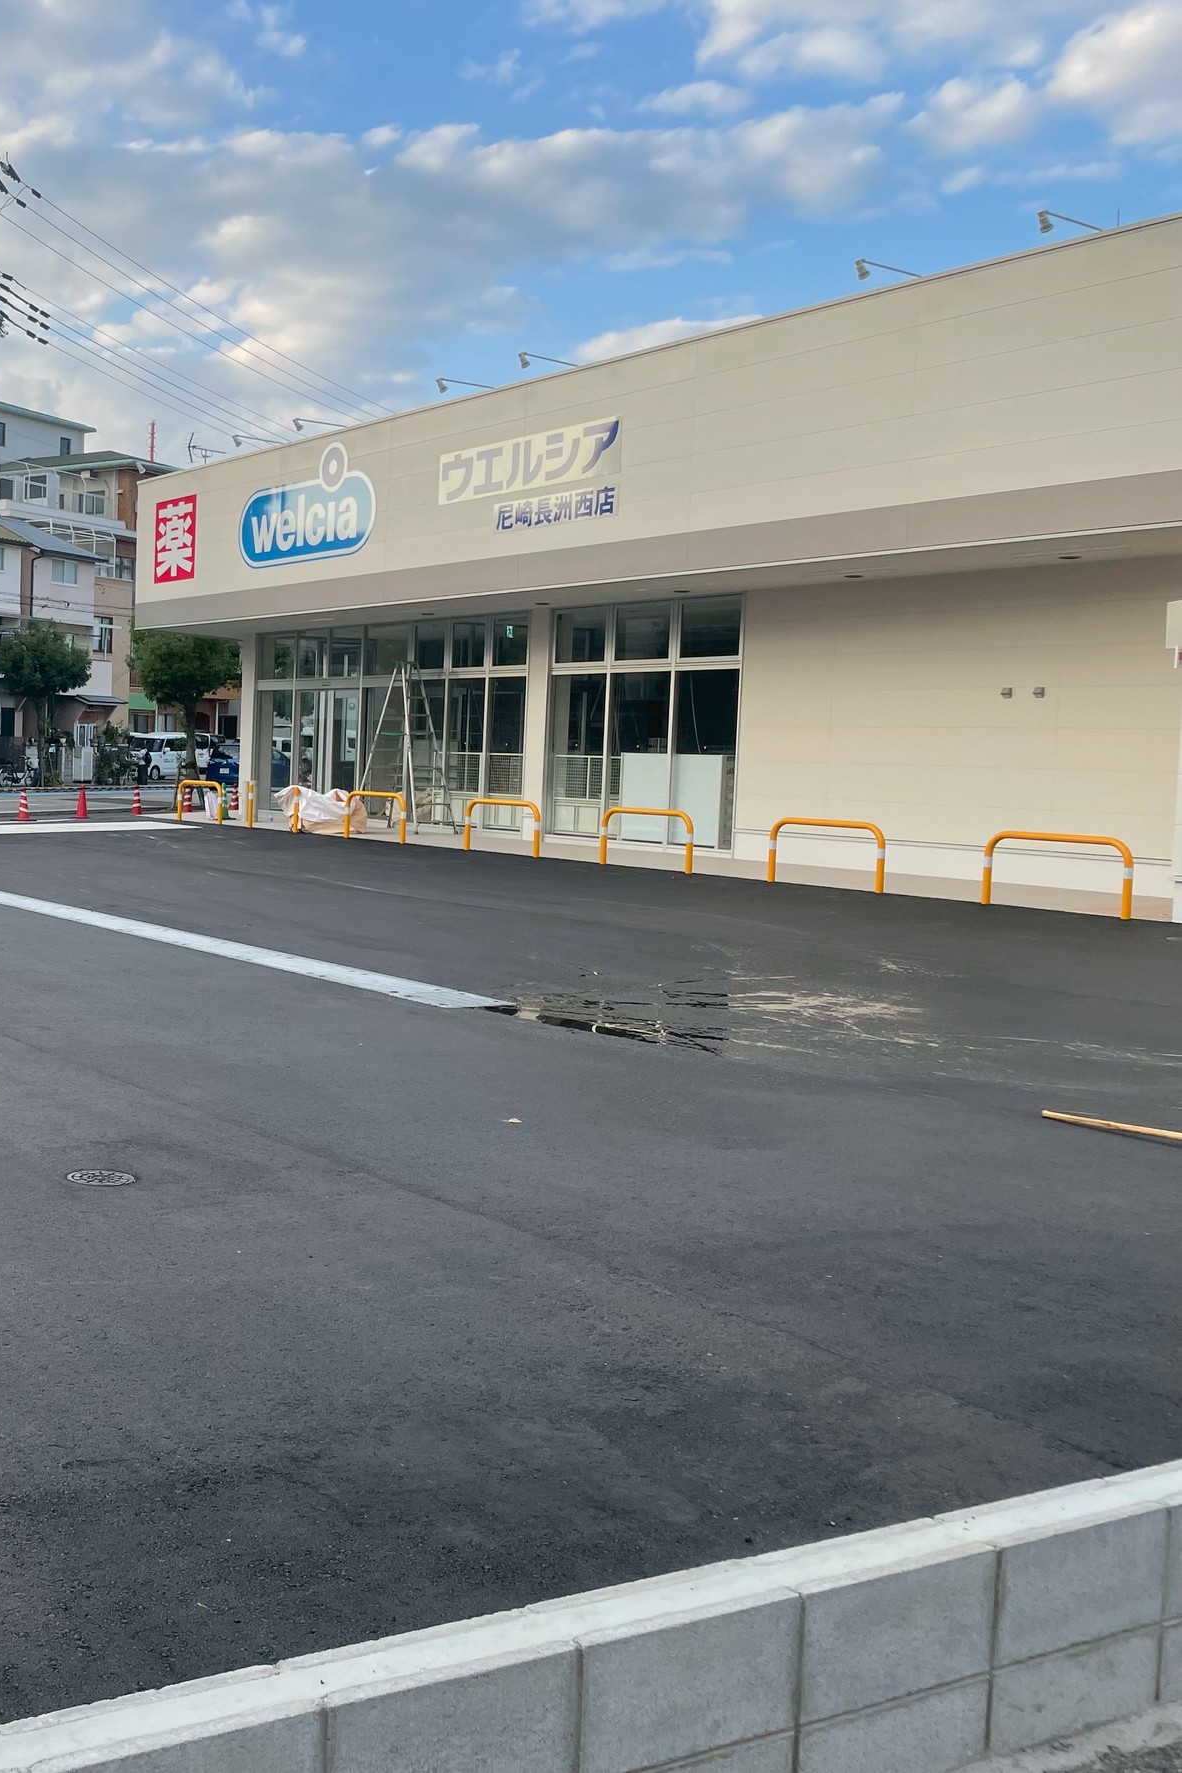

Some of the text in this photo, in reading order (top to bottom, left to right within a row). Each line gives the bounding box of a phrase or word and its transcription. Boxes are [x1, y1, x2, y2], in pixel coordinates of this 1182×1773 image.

[441, 419, 620, 501] ウエルシア
[156, 501, 194, 577] 薬
[251, 493, 358, 554] welcia
[496, 486, 616, 531] 尼崎長洲西店
